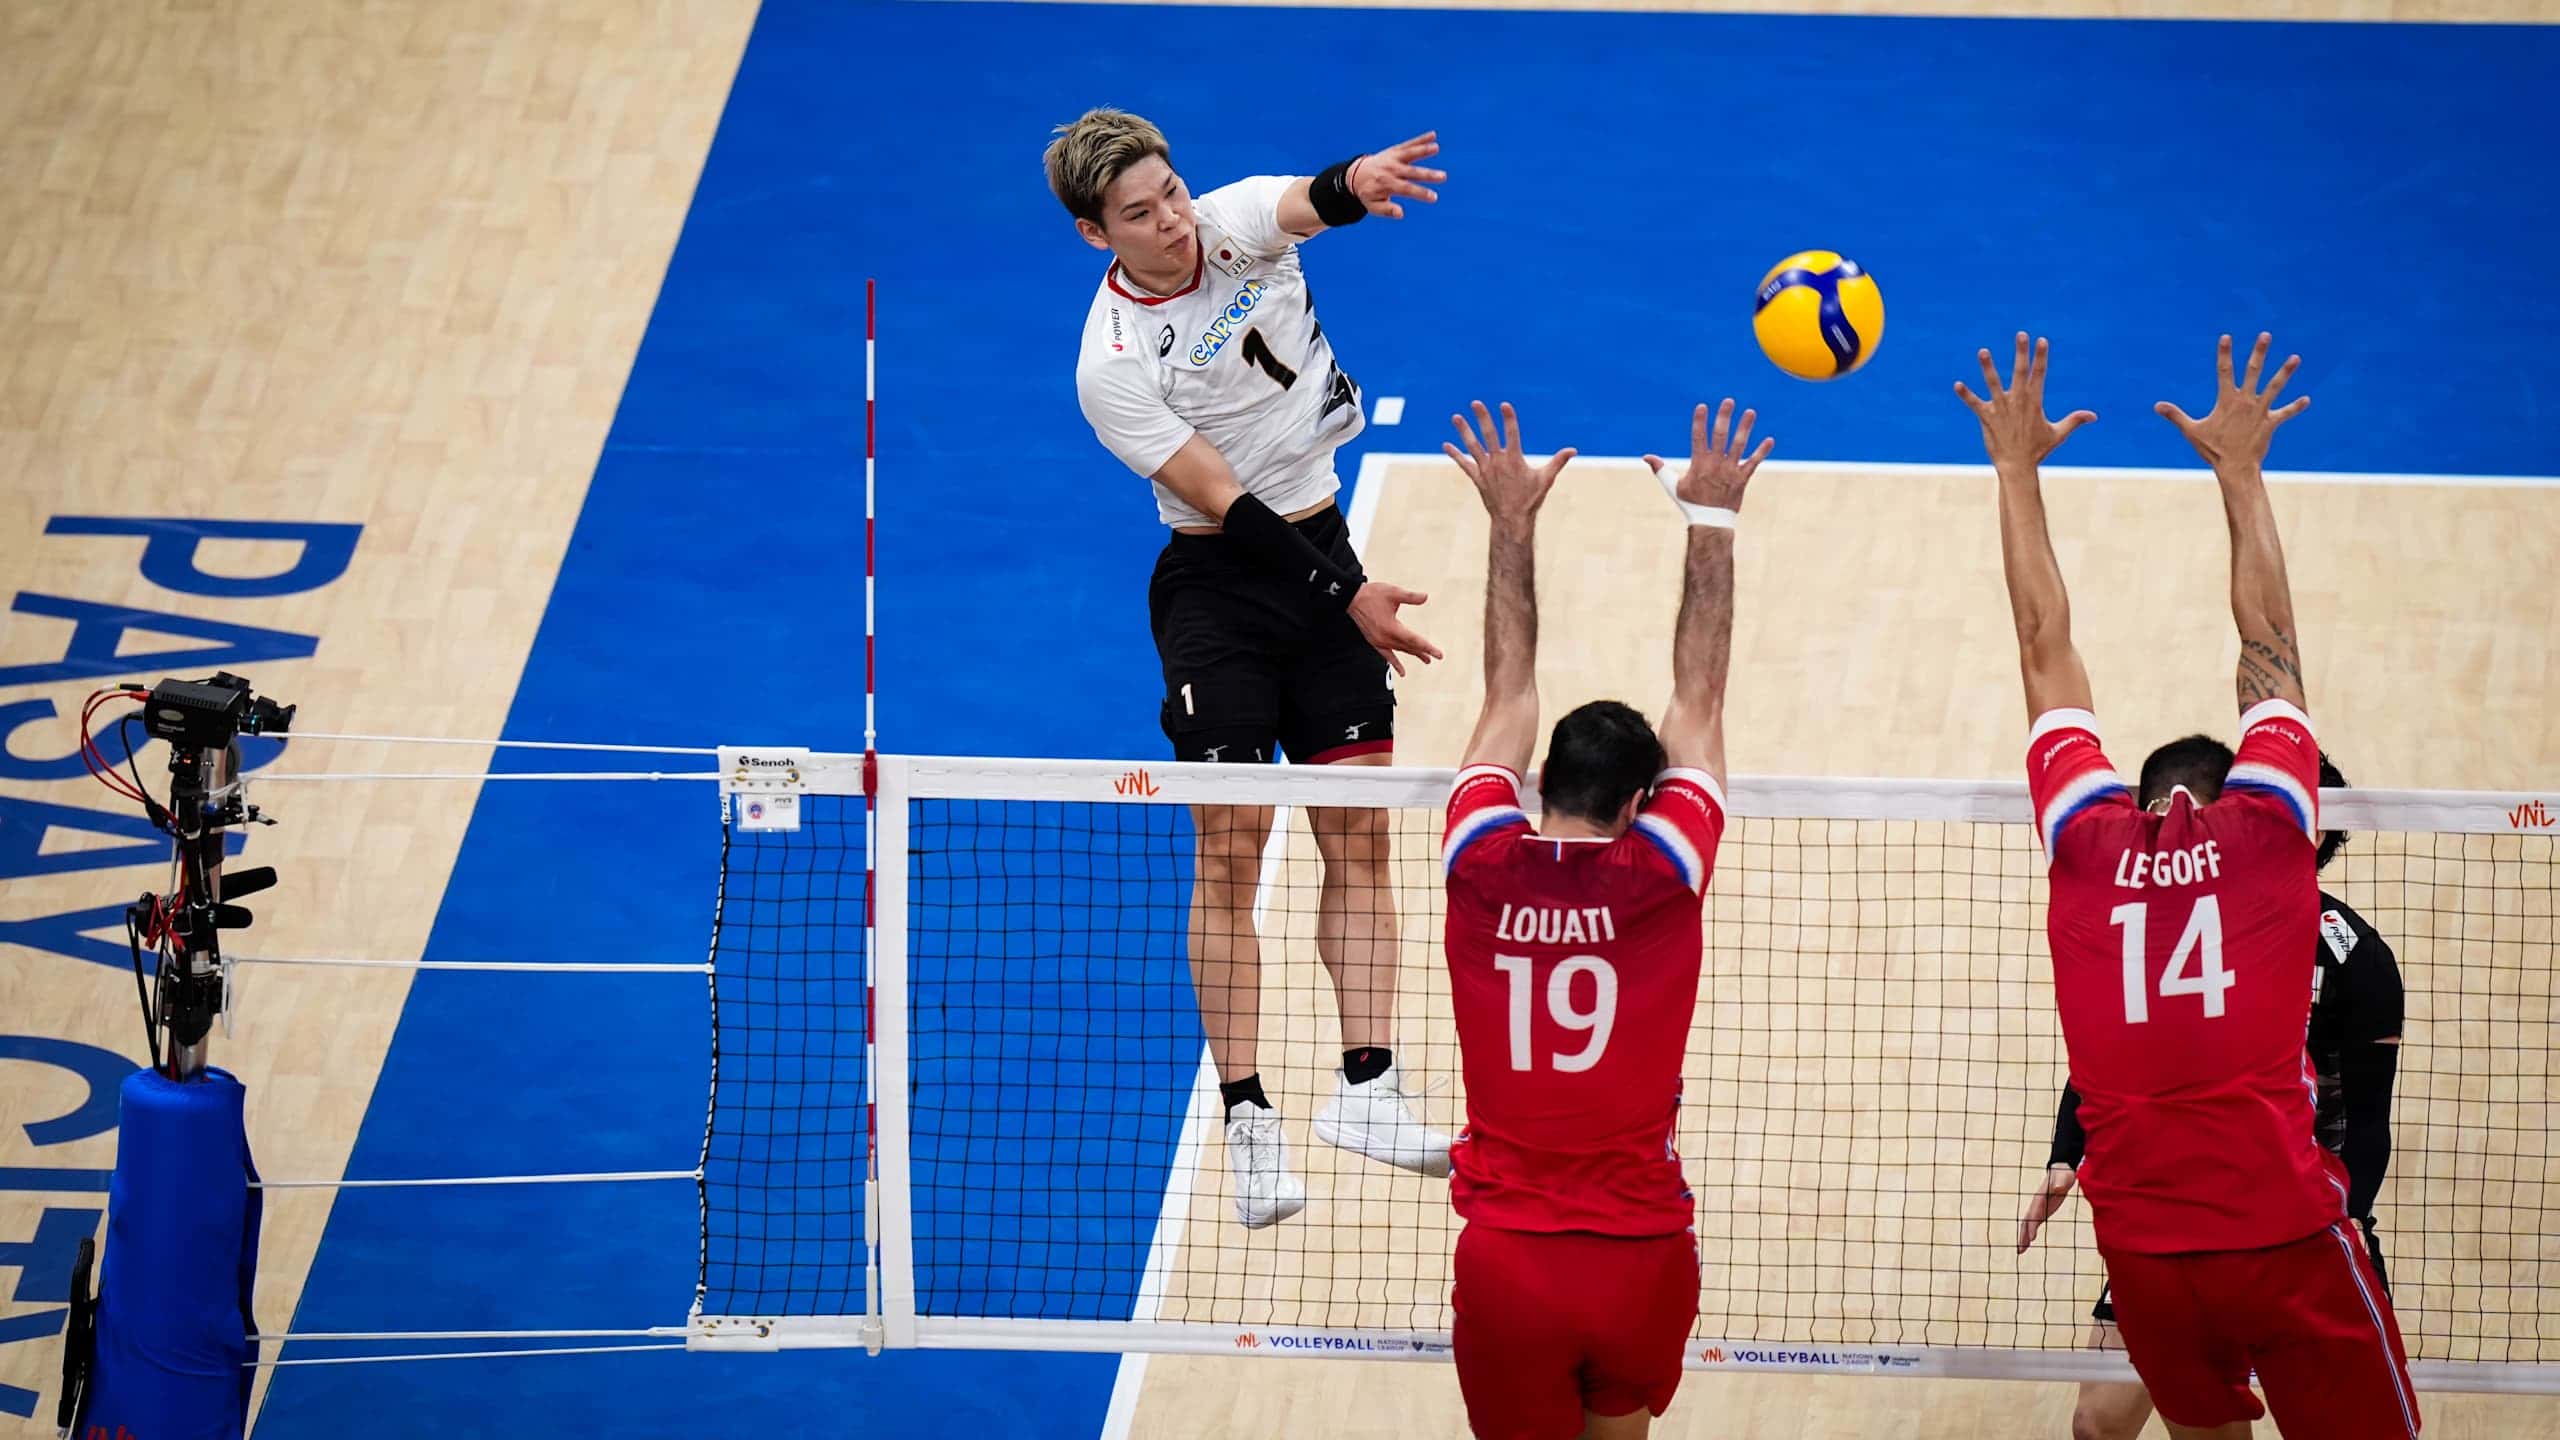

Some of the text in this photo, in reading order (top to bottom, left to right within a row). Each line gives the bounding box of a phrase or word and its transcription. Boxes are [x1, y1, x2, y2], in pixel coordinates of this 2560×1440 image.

[1230, 258, 1249, 275] JPN
[1241, 326, 1298, 392] 1
[1181, 683, 1195, 716] 1
[751, 758, 795, 767] Senoh
[2508, 799, 2556, 829] VNL
[1496, 903, 1616, 945] LOUATI
[2109, 893, 2237, 1025] 14
[1494, 953, 1619, 1074] 19
[1235, 1332, 1261, 1349] VNL
[1269, 1336, 1375, 1351] VOLLEYBALL
[1701, 1346, 1726, 1363] VNL
[1734, 1351, 1840, 1365] VOLLEYBALL
